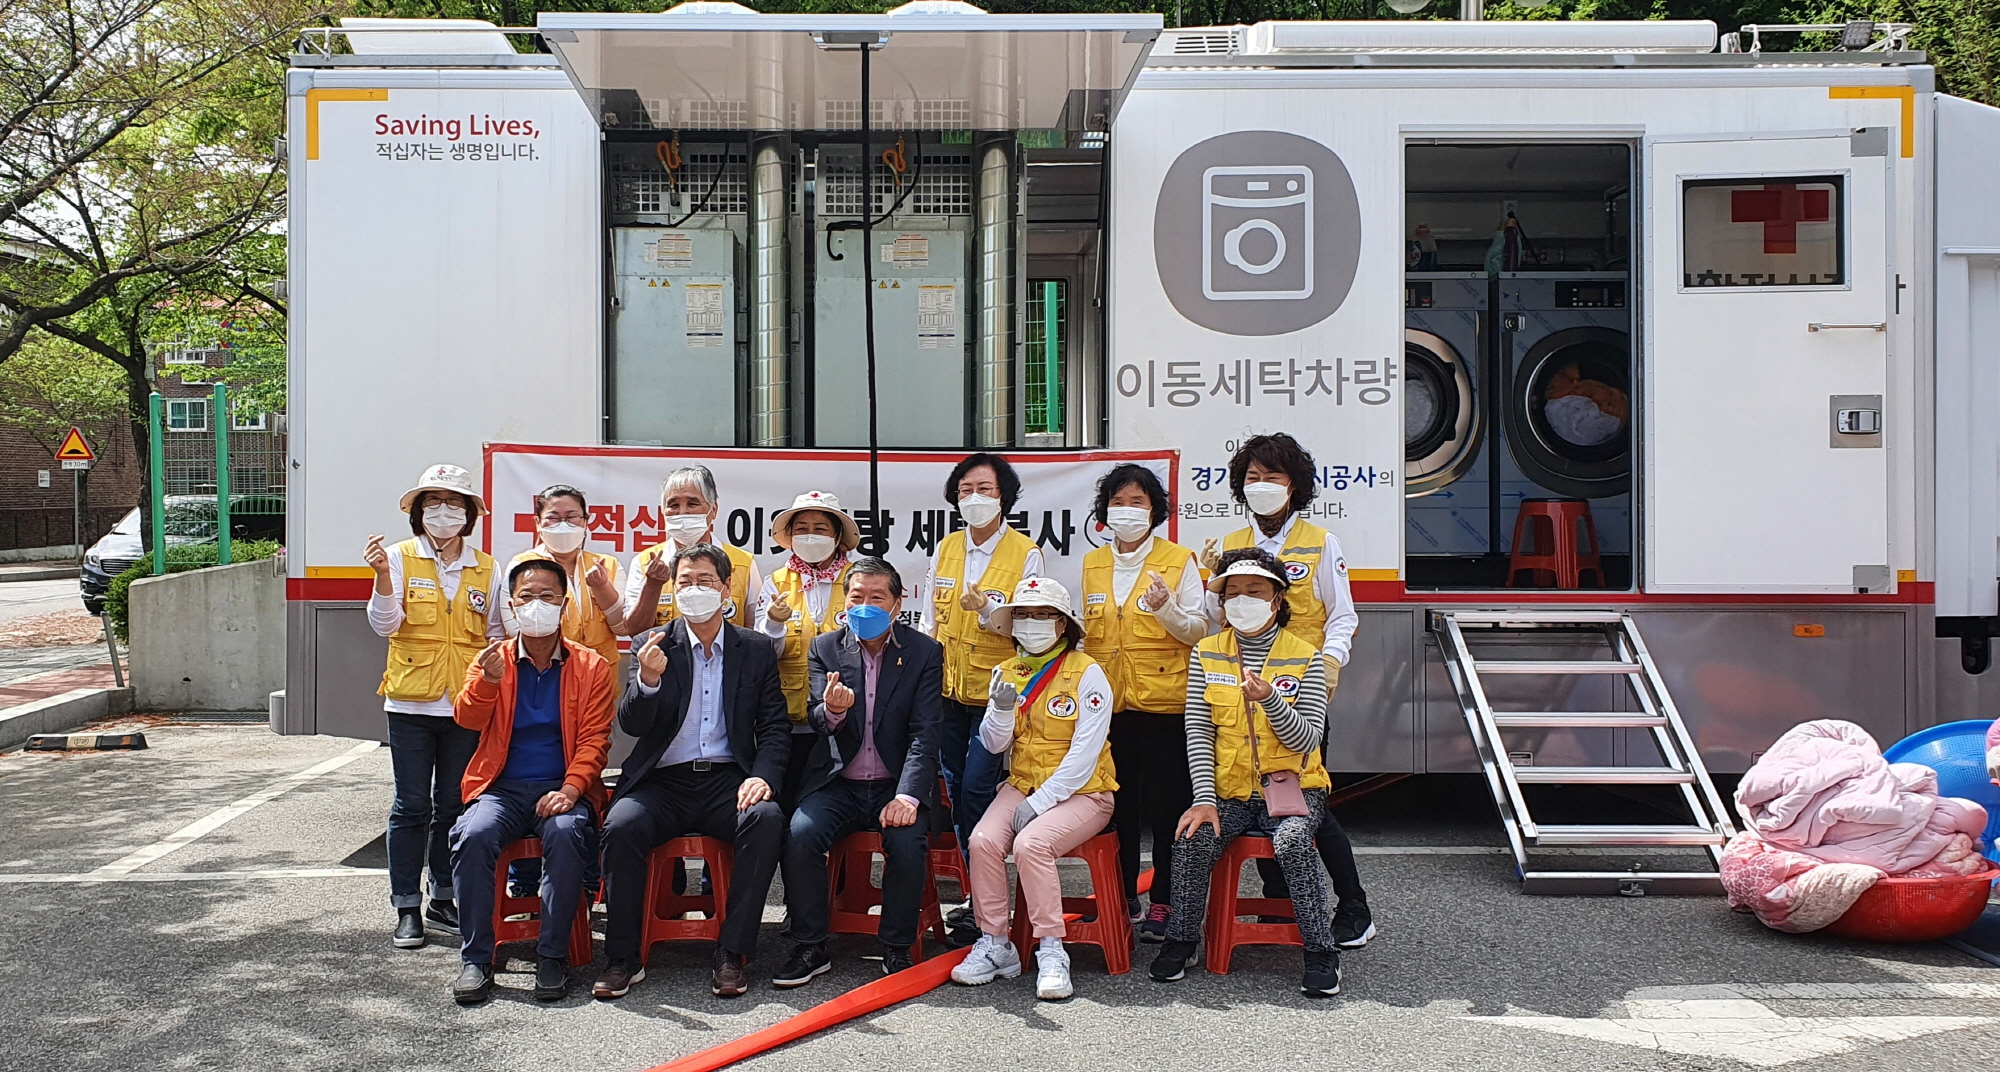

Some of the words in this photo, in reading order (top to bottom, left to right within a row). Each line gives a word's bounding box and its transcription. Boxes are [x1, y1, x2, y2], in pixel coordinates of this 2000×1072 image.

[375, 113, 461, 141] Saving
[469, 113, 541, 139] Lives,
[376, 142, 445, 161] 적십자는
[449, 142, 540, 161] 생명입니다.
[1116, 357, 1398, 408] 이동세탁차량
